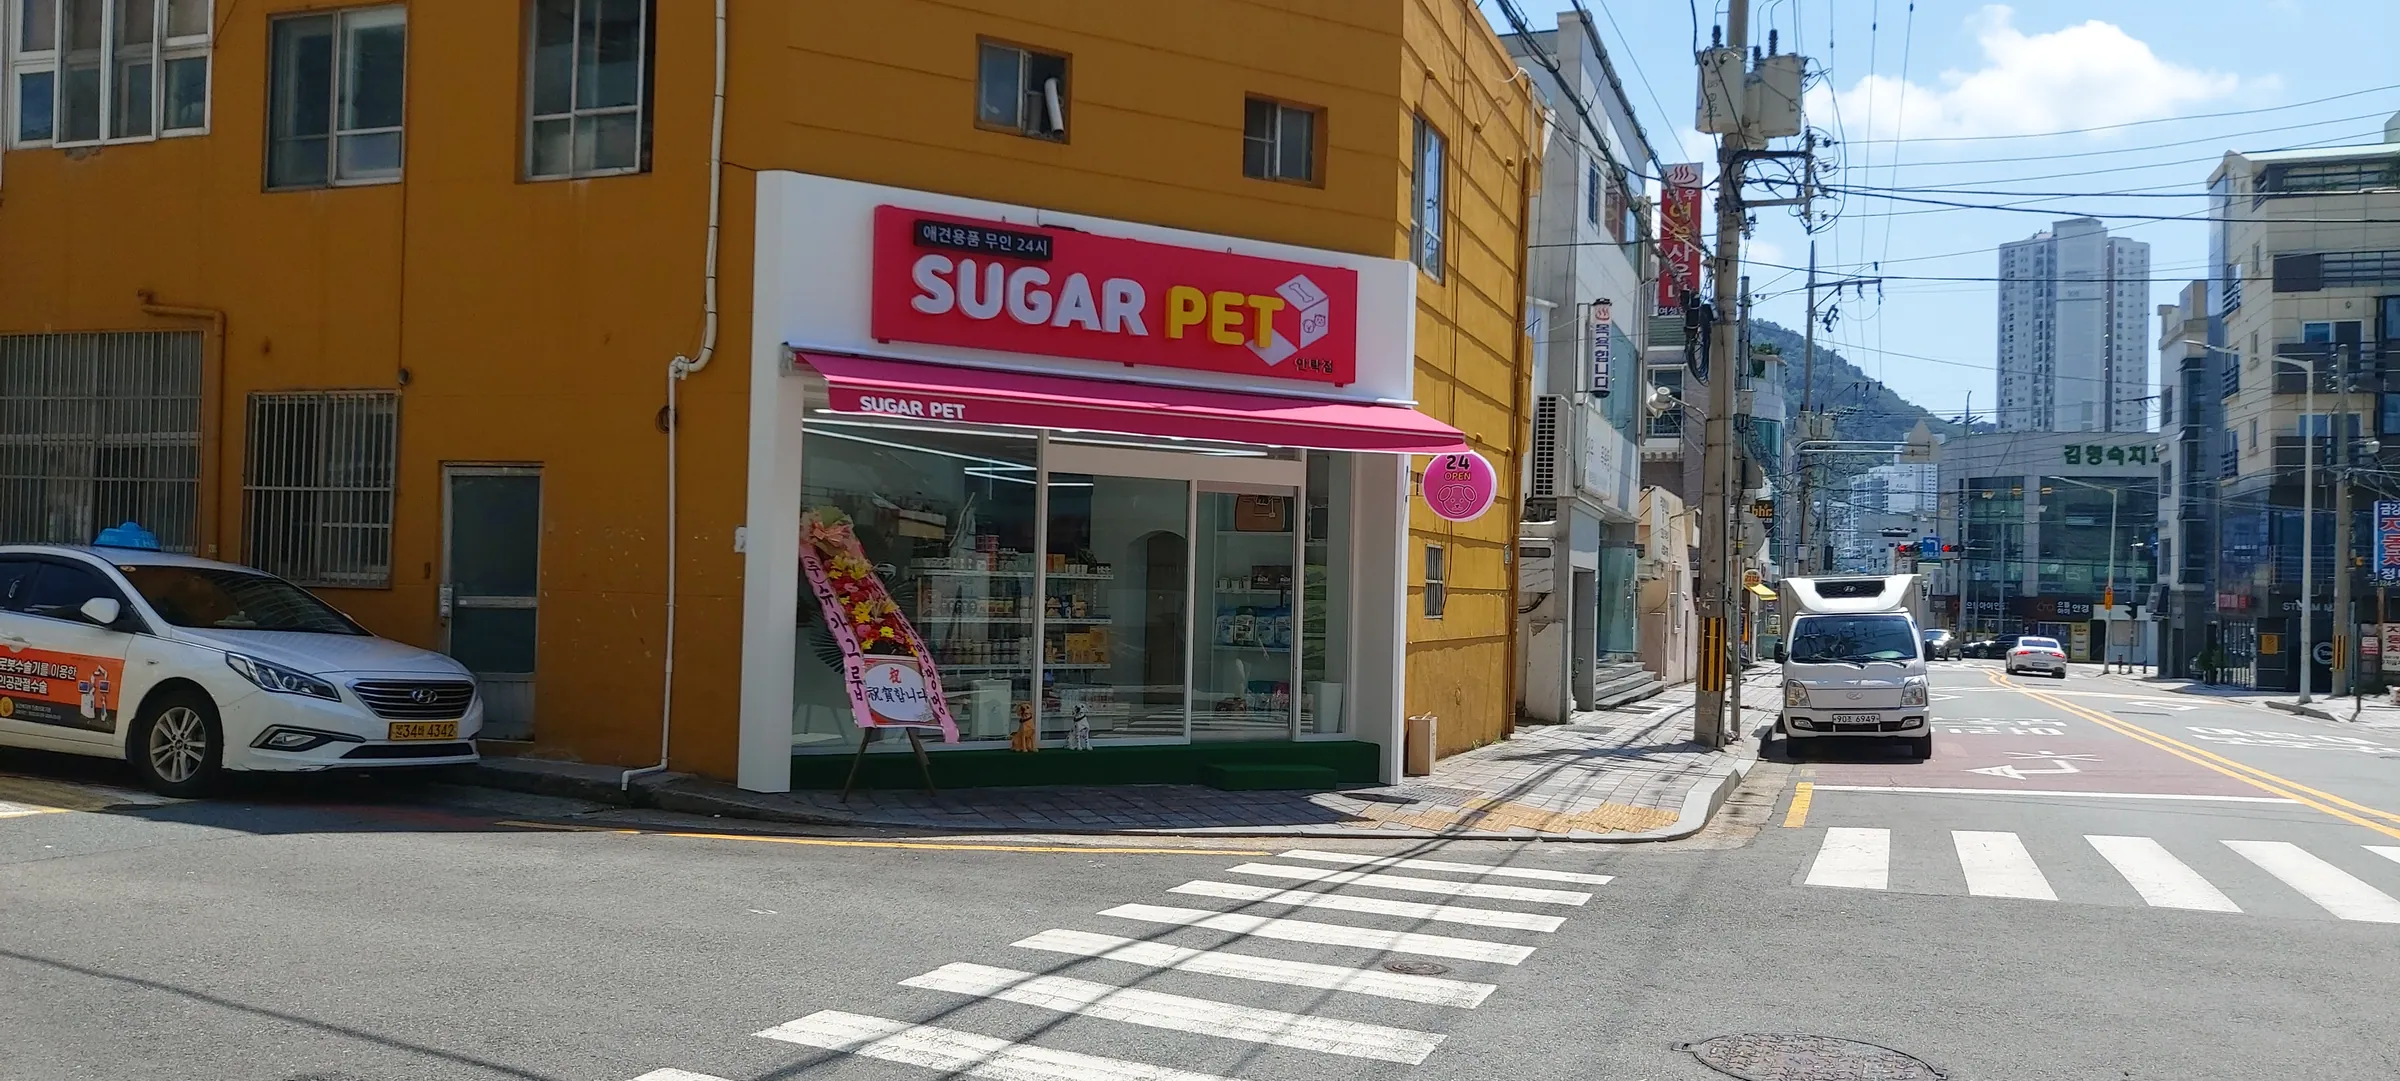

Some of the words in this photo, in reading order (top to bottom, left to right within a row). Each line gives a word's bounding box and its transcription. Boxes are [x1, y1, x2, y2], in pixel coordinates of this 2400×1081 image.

[923, 224, 981, 248] 애견용품
[985, 233, 1012, 251] 무인
[1017, 238, 1048, 256] 24시
[911, 253, 1150, 337] SUGAR
[1164, 285, 1286, 349] PET
[1594, 323, 1610, 390] 목욕합니다
[1294, 358, 1333, 374] 안락점
[859, 395, 925, 417] SUGAR
[929, 401, 966, 420] PET
[1446, 454, 1470, 471] 24
[1444, 472, 1471, 481] OPEN
[1751, 504, 1773, 517] bhc
[2381, 568, 2400, 580] 정
[51, 663, 77, 680] 이용한
[1855, 714, 1876, 723] 6949
[427, 724, 455, 737] 4342
